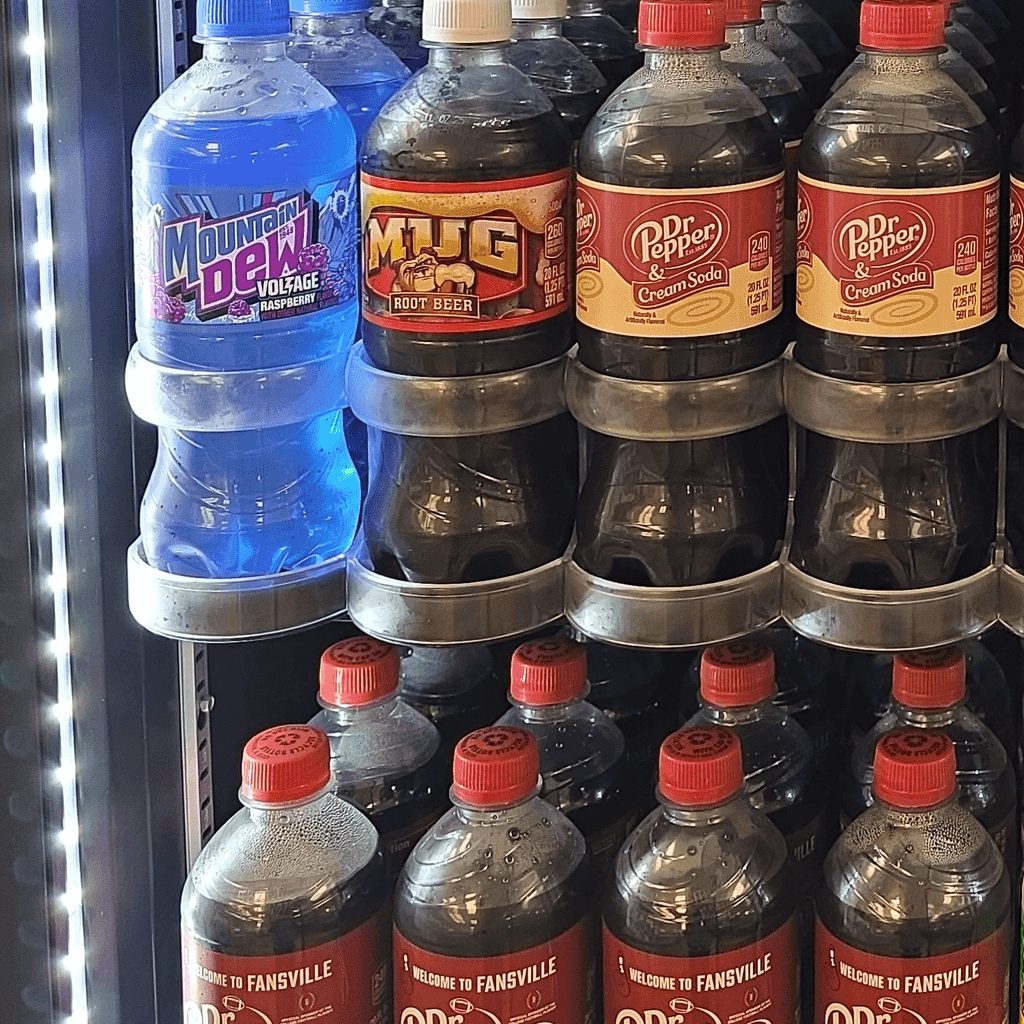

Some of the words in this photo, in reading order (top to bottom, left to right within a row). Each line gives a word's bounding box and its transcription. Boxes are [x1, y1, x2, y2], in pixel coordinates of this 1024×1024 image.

[548, 222, 562, 240] 260
[662, 214, 695, 235] Dr
[868, 214, 899, 233] Dr
[368, 217, 518, 275] MUG
[630, 220, 716, 263] Pepper
[752, 236, 768, 254] 240
[839, 218, 920, 261] Pepper
[958, 241, 976, 257] 240
[649, 264, 667, 281] &
[855, 262, 870, 279] &
[257, 271, 319, 298] VOLTAGE
[637, 280, 687, 304] Cream
[688, 268, 723, 288] Soda
[748, 281, 755, 292] 20
[845, 280, 890, 301] Cream
[892, 268, 926, 288] Soda
[953, 286, 961, 297] 20
[261, 292, 316, 312] RASPBERRY
[394, 297, 427, 310] ROOT
[433, 296, 473, 312] BEER
[195, 962, 227, 987] ELCOME
[230, 975, 242, 989] TO
[248, 959, 332, 992] FANSVILLE
[413, 965, 455, 990] WELCOME
[459, 978, 471, 991] TO
[477, 956, 557, 993] FANSVILLE
[629, 967, 675, 991] WELCOME
[679, 977, 692, 991] TO
[697, 953, 772, 992] FANSVILLE
[840, 961, 884, 989] WELCOME
[887, 977, 900, 990] TO
[905, 961, 980, 993] FANSVILLE
